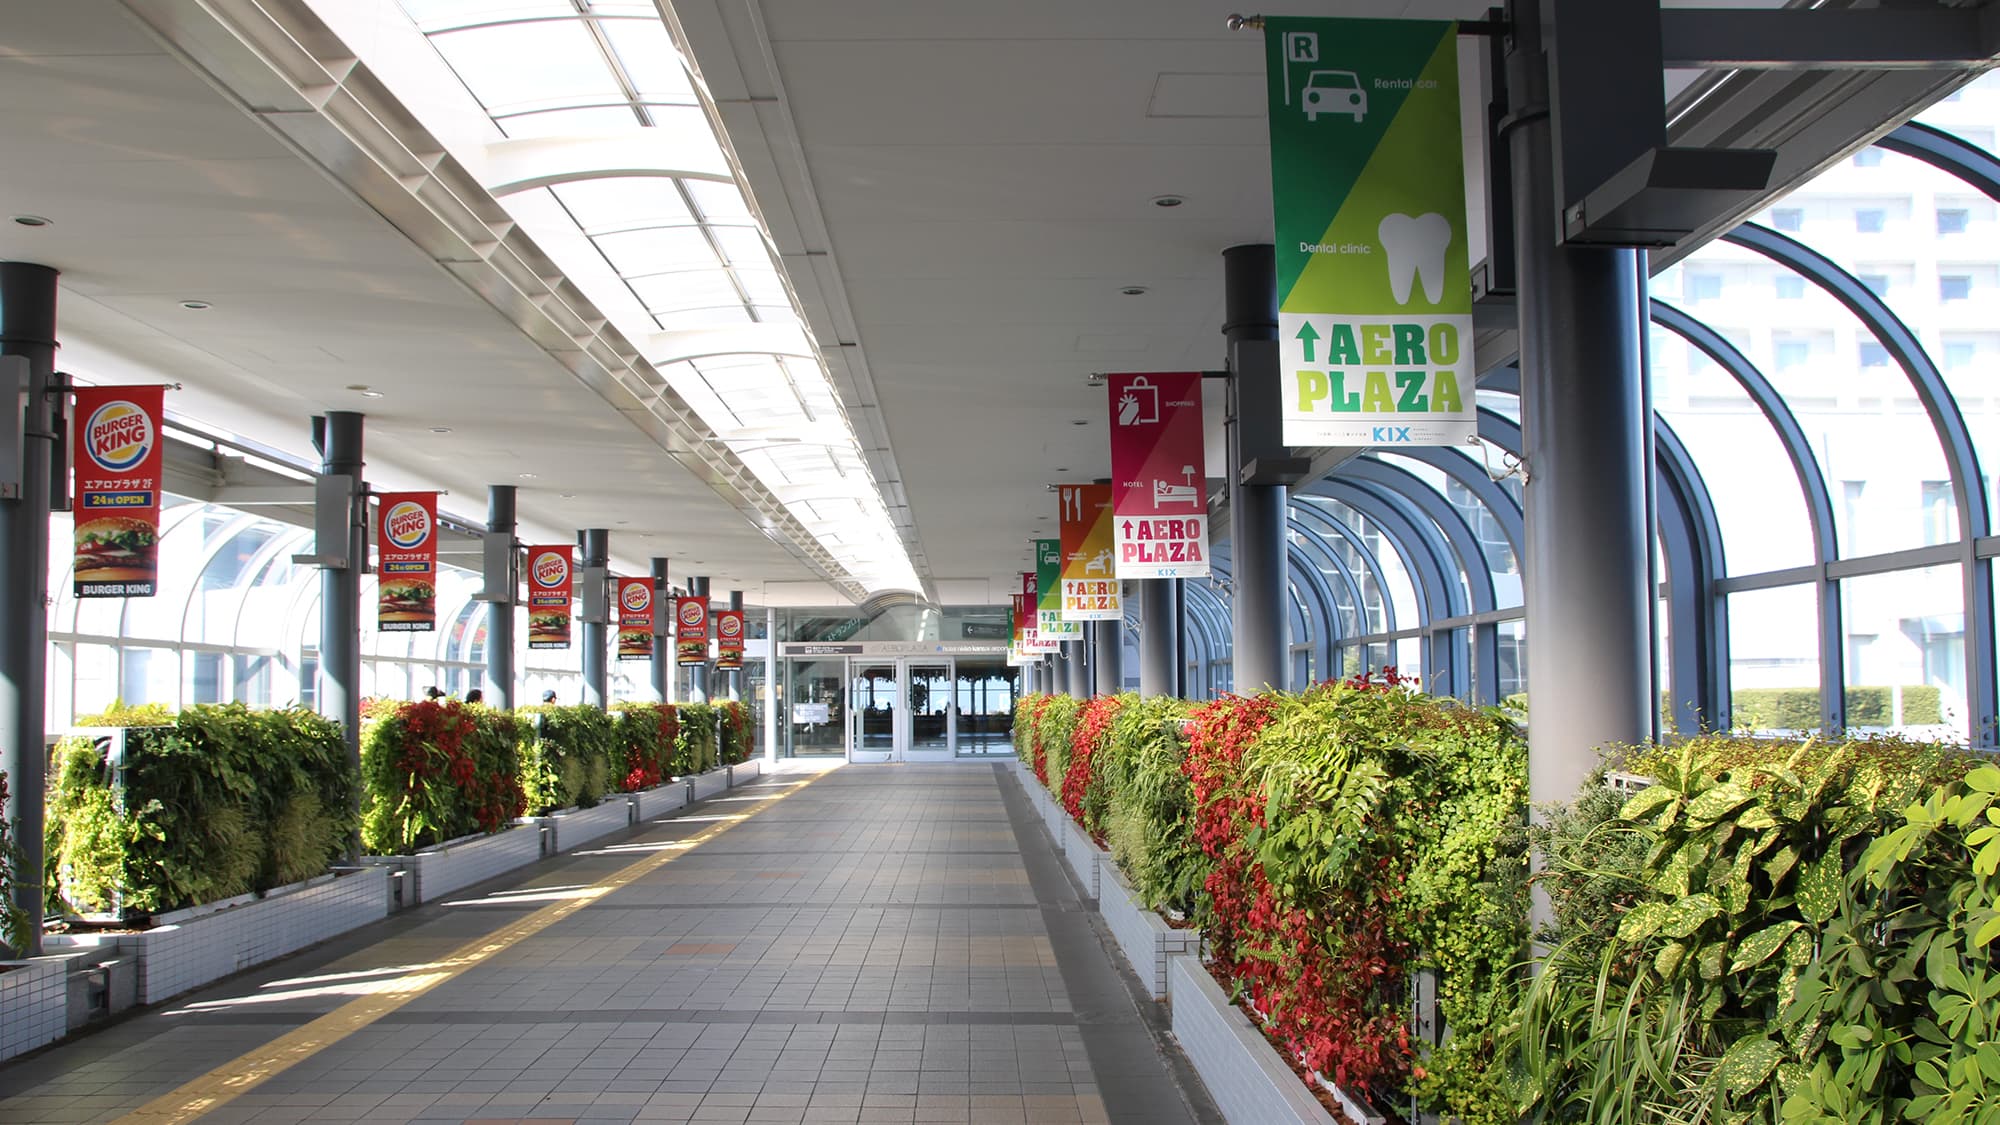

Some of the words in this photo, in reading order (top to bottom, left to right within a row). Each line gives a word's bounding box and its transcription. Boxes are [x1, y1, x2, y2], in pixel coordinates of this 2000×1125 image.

[1294, 37, 1313, 59] R
[1374, 78, 1413, 89] Rental
[1416, 80, 1438, 89] car
[1300, 242, 1336, 254] Dental
[1340, 244, 1371, 255] clinic
[1328, 323, 1460, 366] AERO
[1296, 371, 1464, 413] PLAZA
[94, 413, 144, 441] BURGER
[1372, 427, 1411, 442] KIX
[96, 426, 146, 458] KING
[117, 495, 145, 505] OPEN
[390, 511, 424, 528] BURGER
[391, 518, 425, 539] KING
[1137, 519, 1200, 540] AERO
[1122, 541, 1202, 563] PLAZA
[538, 565, 564, 580] KING
[1158, 568, 1176, 577] KIX
[82, 584, 125, 596] BURGER
[126, 583, 152, 595] KING
[1076, 581, 1119, 595] AERO
[626, 594, 647, 605] KING
[1066, 596, 1119, 610] PLAZA
[1041, 622, 1080, 633] PLAZA
[1026, 638, 1057, 648] PLAZA
